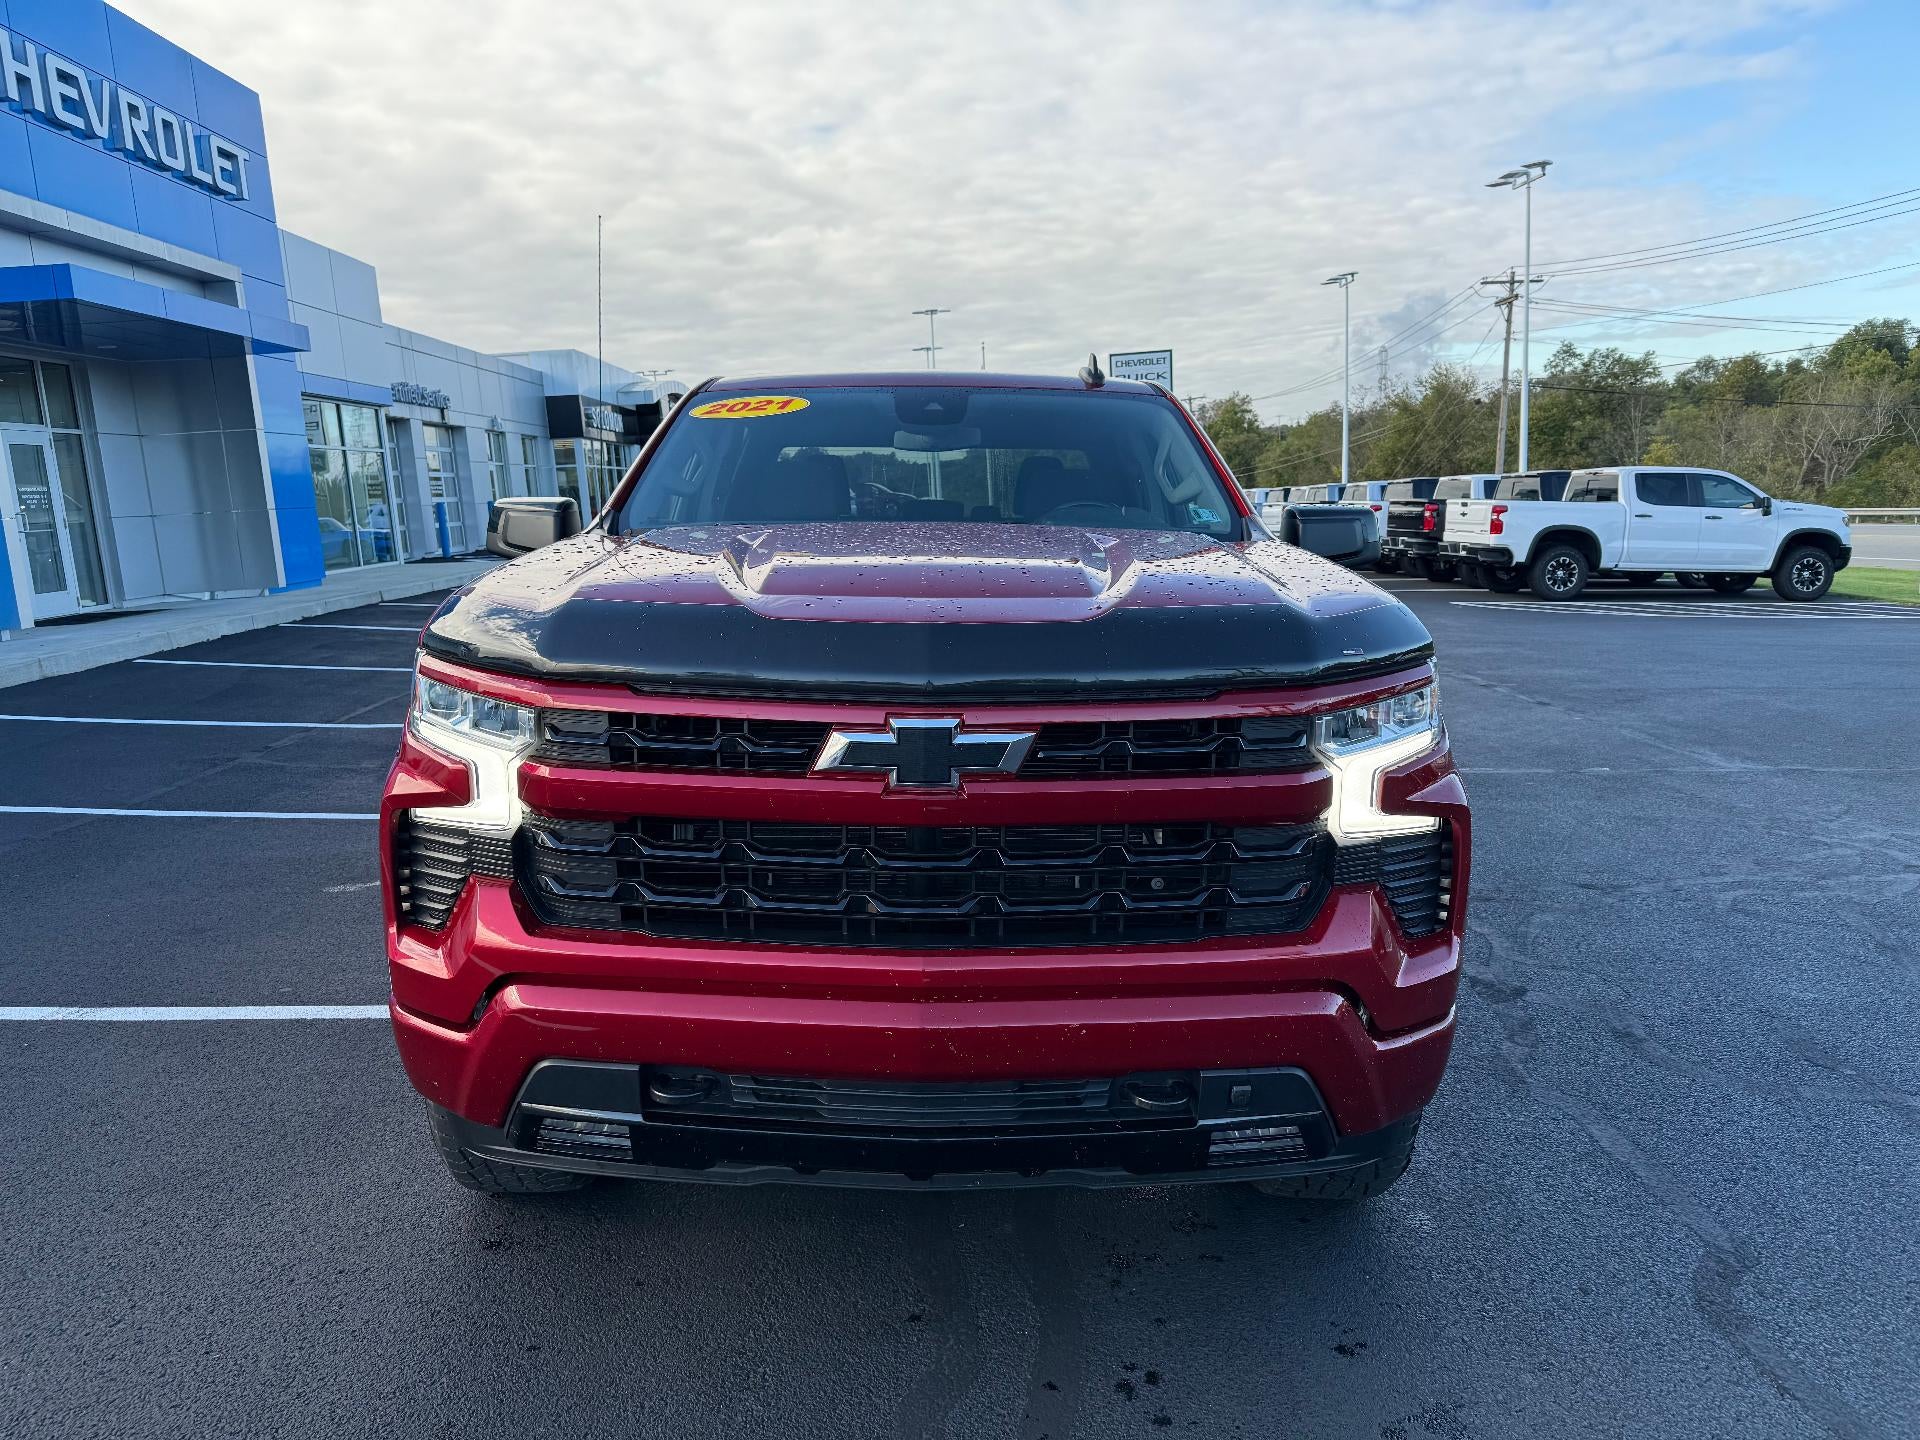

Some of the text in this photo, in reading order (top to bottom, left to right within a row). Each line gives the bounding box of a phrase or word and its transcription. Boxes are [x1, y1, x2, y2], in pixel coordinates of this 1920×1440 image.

[0, 27, 250, 201] HEVROLET
[1115, 357, 1166, 367] CHEVROLET
[700, 399, 794, 415] 2021
